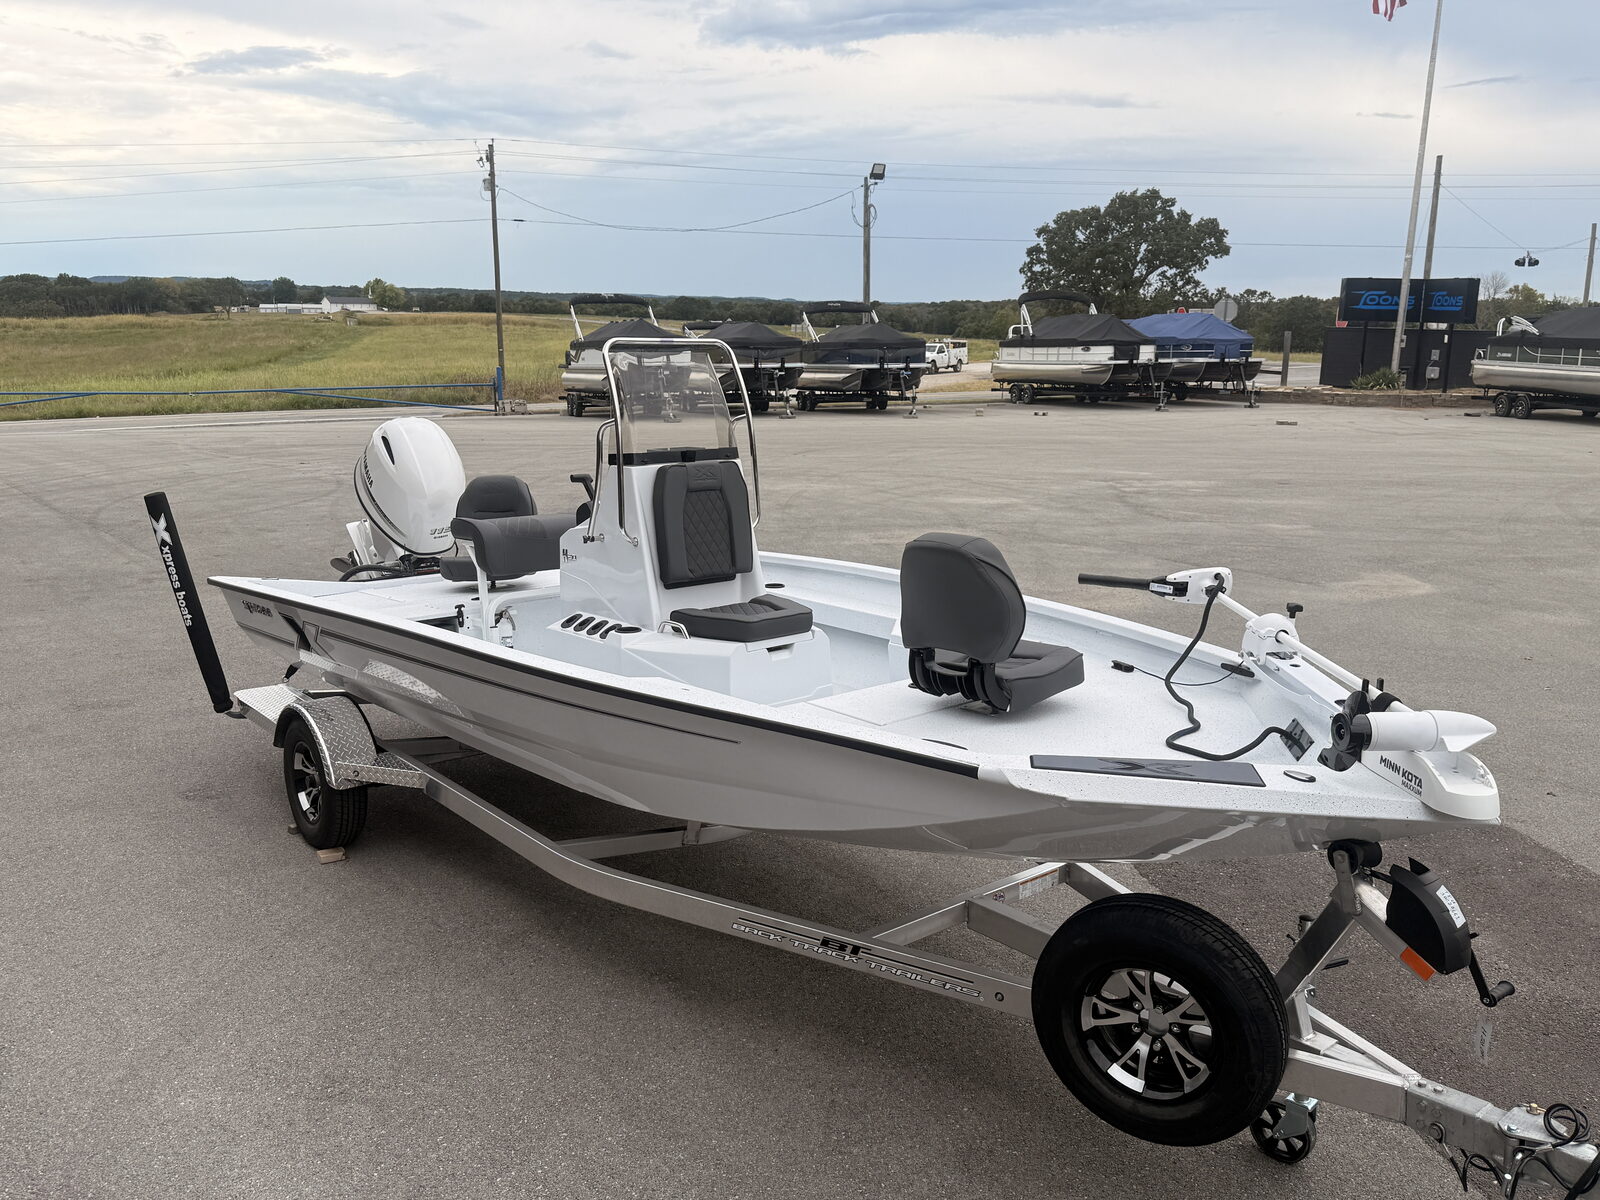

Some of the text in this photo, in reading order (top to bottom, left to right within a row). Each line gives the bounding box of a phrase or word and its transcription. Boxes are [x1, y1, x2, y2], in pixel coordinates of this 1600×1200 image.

[1427, 291, 1464, 311] TOONS
[175, 590, 193, 628] boats
[1379, 754, 1423, 790] MINN KOTA
[731, 922, 981, 997] BACK TRACK TRAILERS
